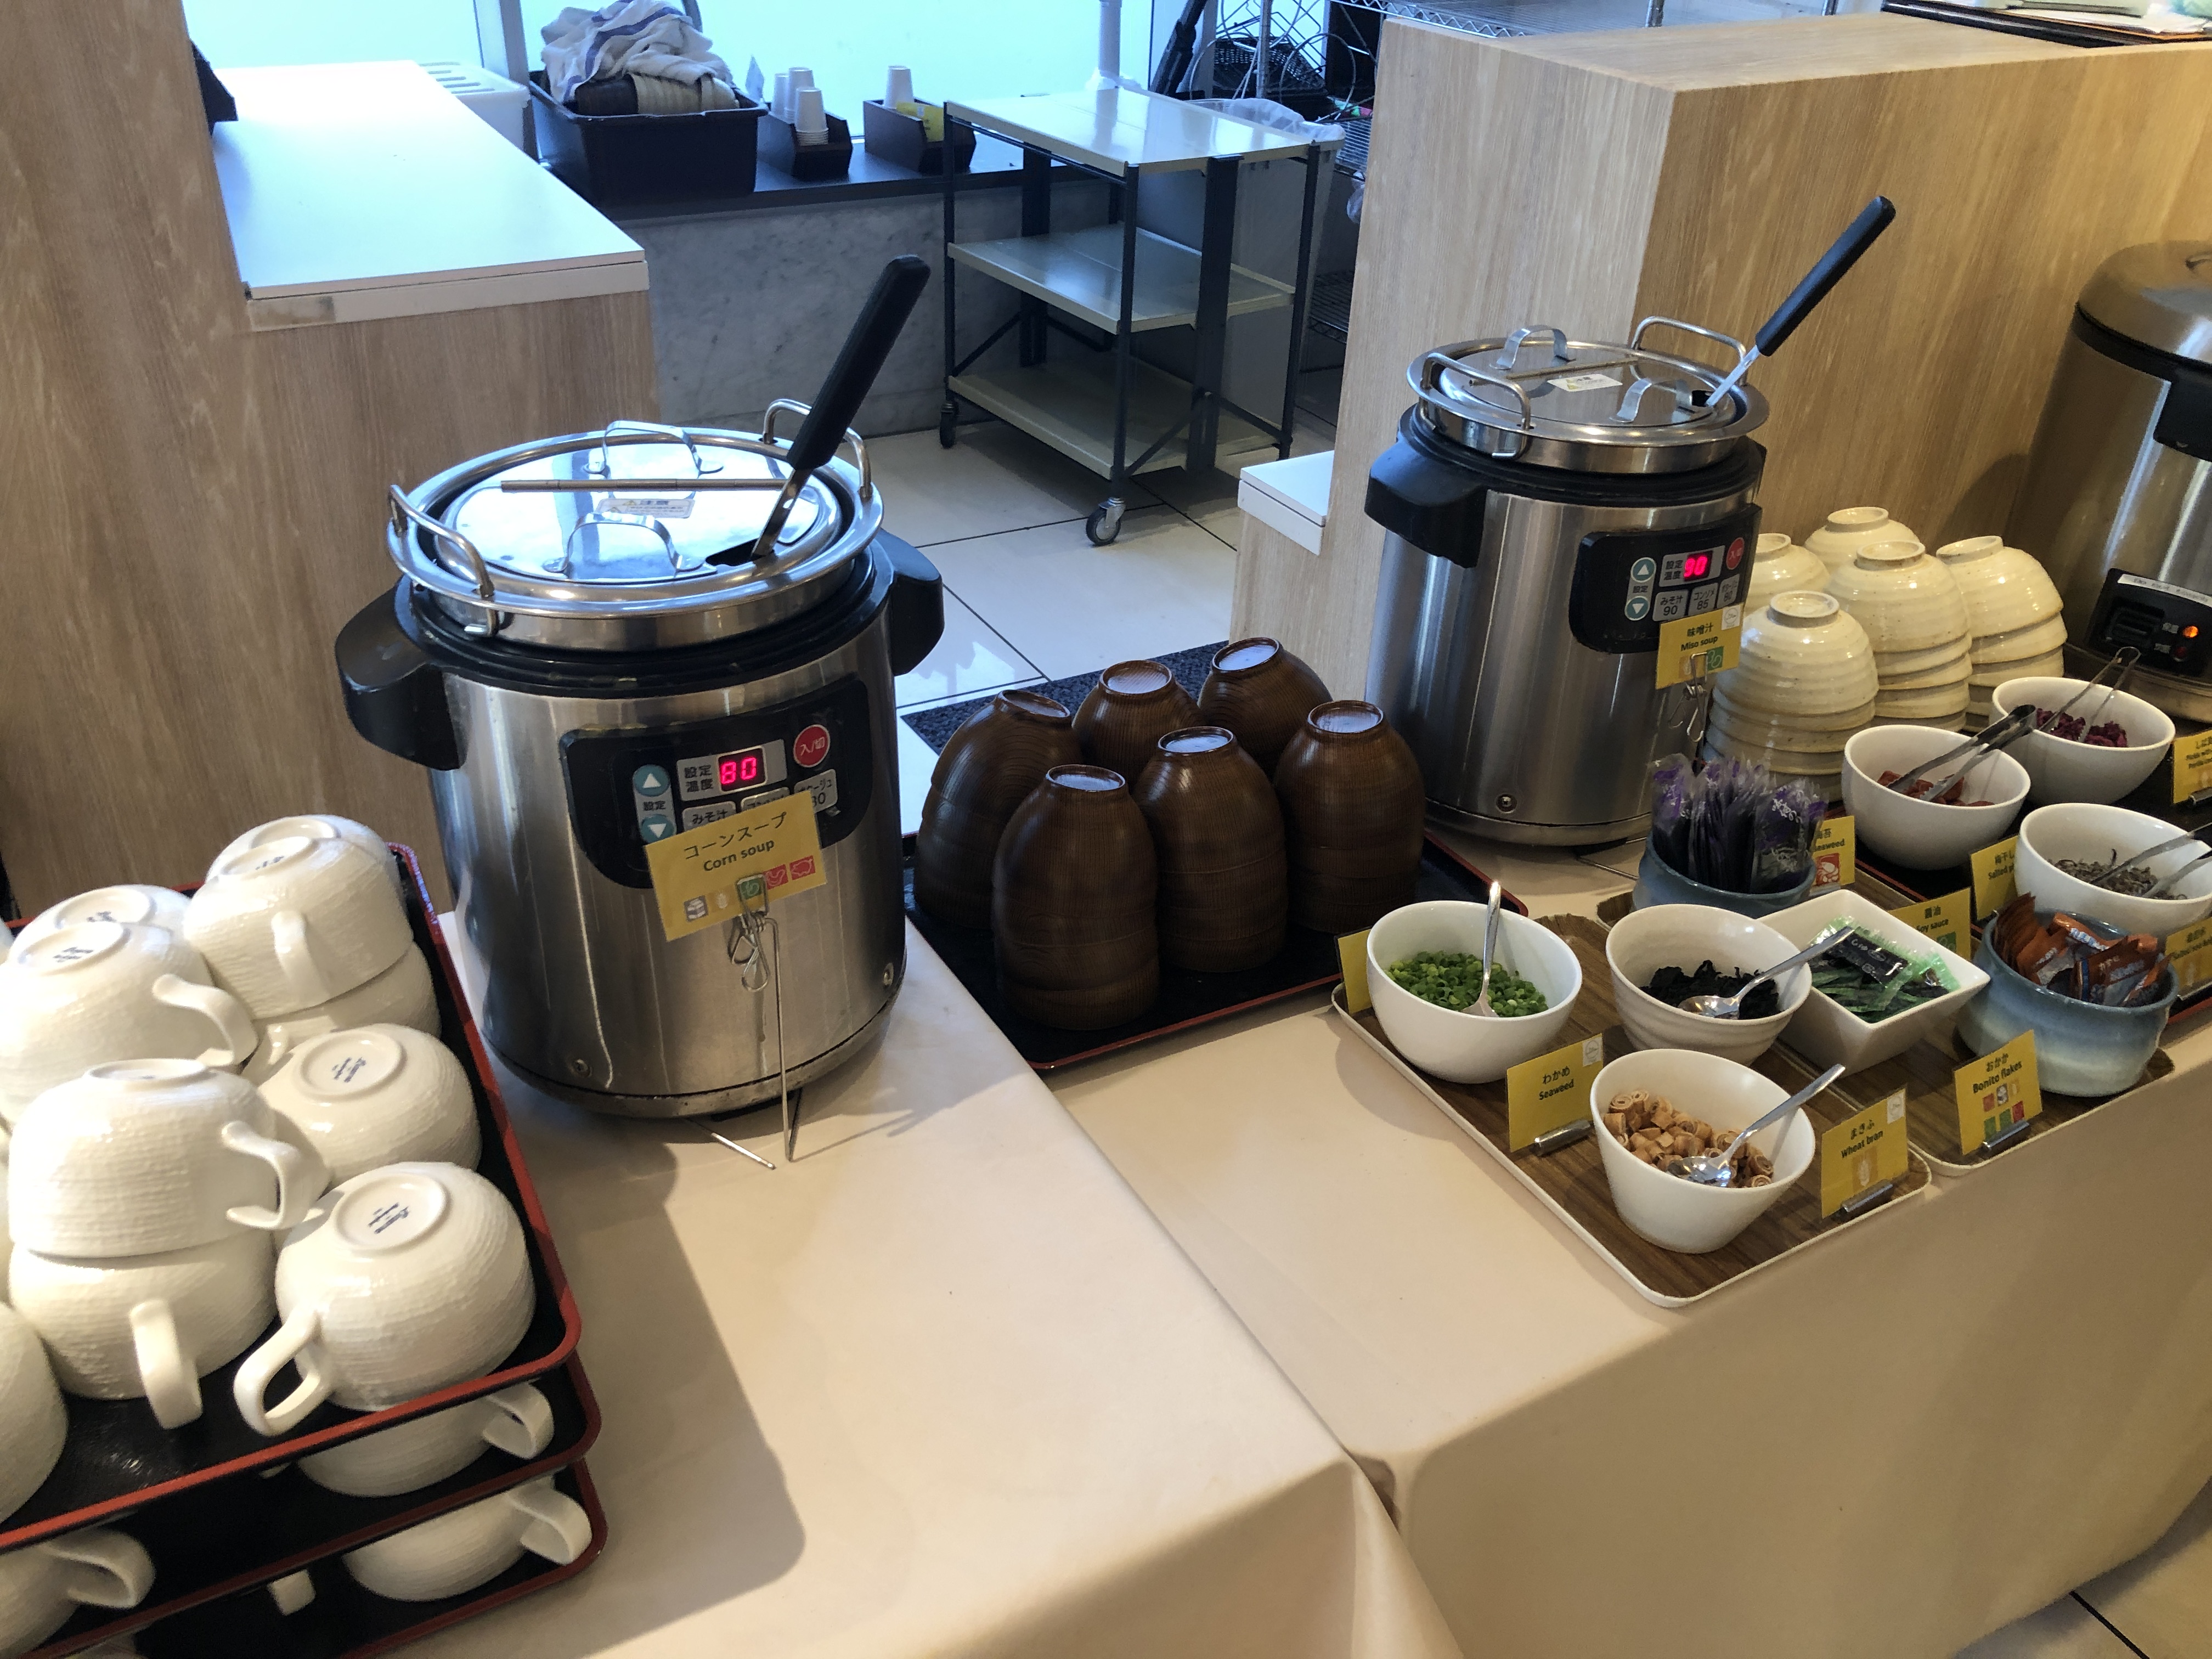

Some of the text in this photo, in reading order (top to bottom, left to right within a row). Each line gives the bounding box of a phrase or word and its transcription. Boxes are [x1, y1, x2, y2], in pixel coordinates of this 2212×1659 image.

[1665, 560, 1683, 569] 設定
[1684, 556, 1708, 578] 90
[1663, 571, 1681, 580] 温度
[1660, 595, 1684, 606] みそ汁
[1694, 588, 1716, 601] コンソメ
[1663, 606, 1678, 616] 90
[1696, 599, 1709, 610] 85
[1681, 636, 1718, 651] Miso soup
[684, 764, 712, 778] 設定
[721, 757, 757, 785] 80
[686, 778, 713, 793] 温度
[643, 800, 666, 811] 設定
[684, 811, 787, 860] コーンスープ
[703, 840, 775, 871] Corn soup
[1931, 919, 1949, 929] sauce
[1542, 1065, 1570, 1085] わかめ
[1539, 1078, 1575, 1100] Seaweed
[1973, 1075, 2000, 1093] Bonito
[1866, 1131, 1883, 1144] bran
